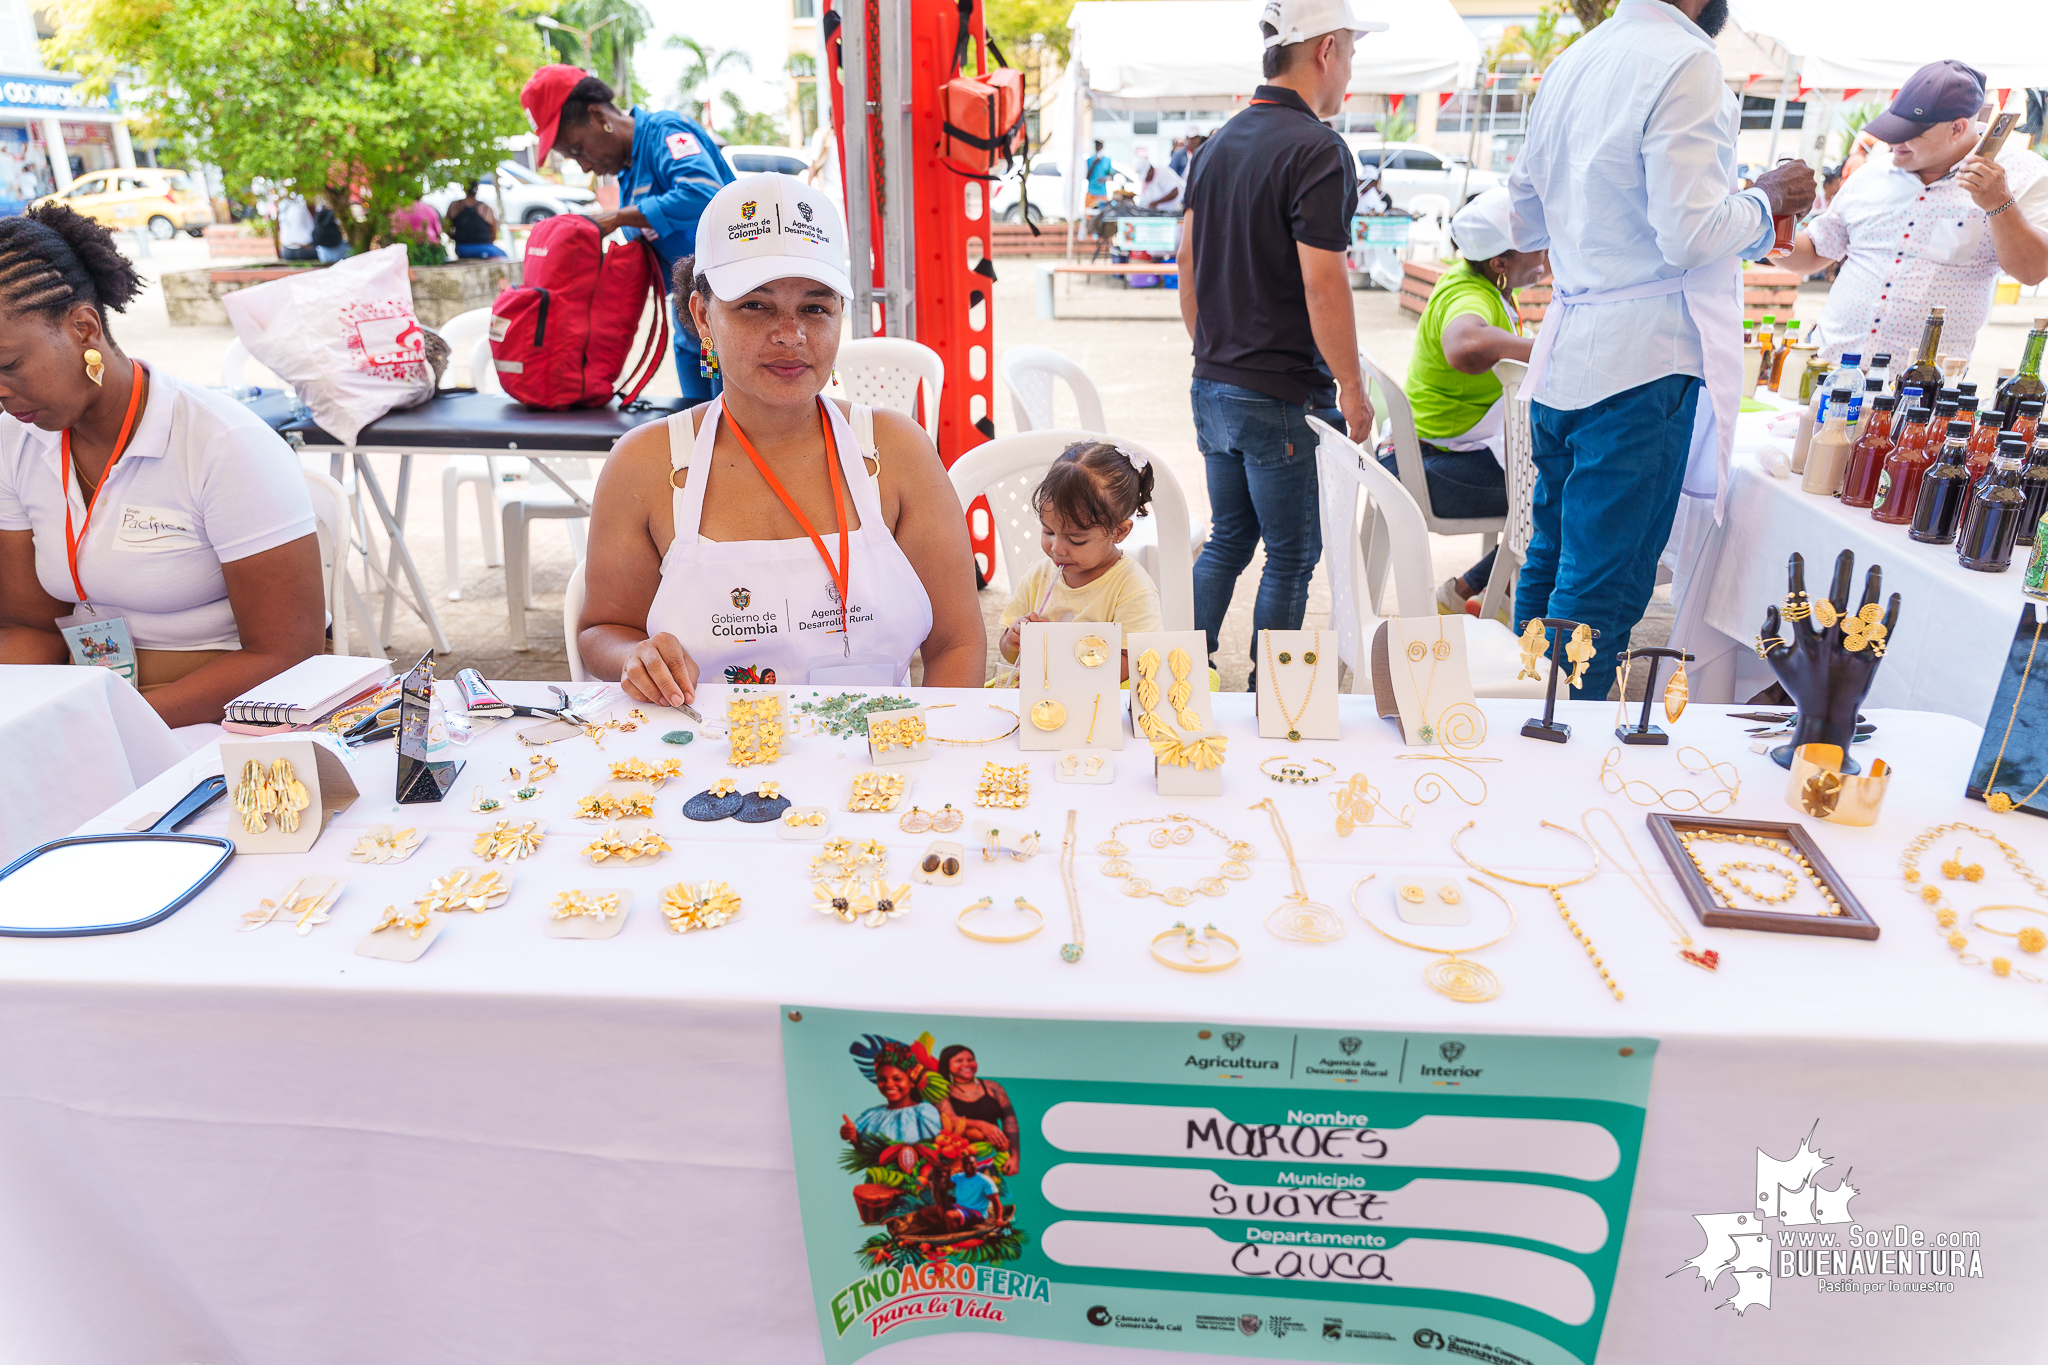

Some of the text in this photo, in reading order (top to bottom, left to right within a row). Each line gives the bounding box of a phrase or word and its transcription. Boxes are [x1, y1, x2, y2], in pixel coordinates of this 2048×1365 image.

[728, 221, 759, 232] Gobierno
[784, 226, 815, 238] Desarrollo
[792, 220, 815, 232] Agencia
[728, 226, 771, 240] Colombia
[374, 350, 425, 364] OLIM
[712, 612, 776, 624] Gobierno de
[811, 605, 862, 618] Agenci de
[850, 613, 874, 623] Rural
[712, 622, 778, 636] Colombia
[1184, 1054, 1279, 1070] Agricultura
[1319, 1058, 1361, 1066] Agencia
[1306, 1066, 1388, 1076] Desarrollo Rural
[1420, 1064, 1483, 1078] Interior
[1286, 1110, 1369, 1126] Nombre
[1277, 1172, 1366, 1190] Municipio
[1246, 1227, 1386, 1248] Departamento
[1231, 1243, 1393, 1281] Cauca
[872, 1296, 1006, 1338] para la Vida
[1115, 1321, 1153, 1329] Comercio
[1448, 1334, 1480, 1347] Cámara
